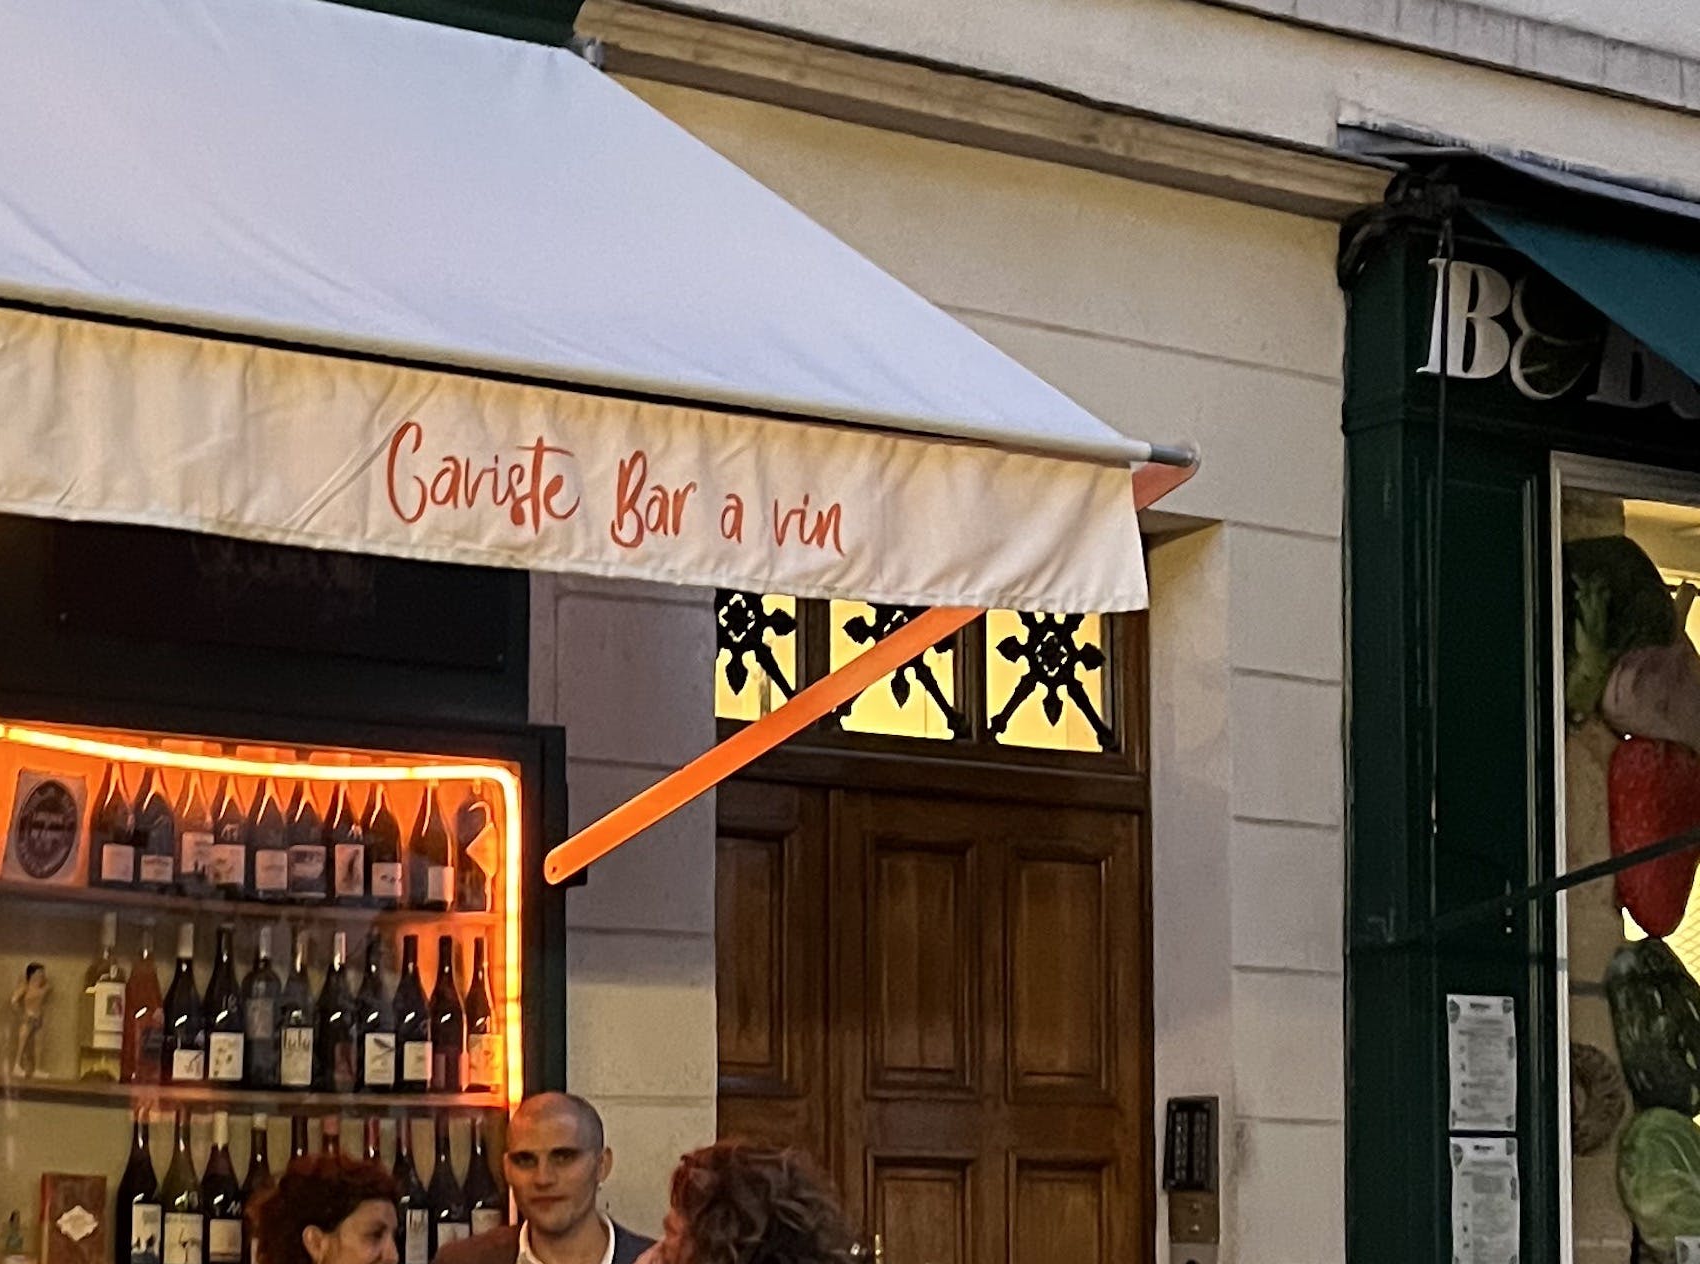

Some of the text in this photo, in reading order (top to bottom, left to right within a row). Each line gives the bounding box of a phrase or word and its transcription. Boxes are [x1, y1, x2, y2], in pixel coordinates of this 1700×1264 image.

[387, 421, 846, 557] Caviste Bar a vin
